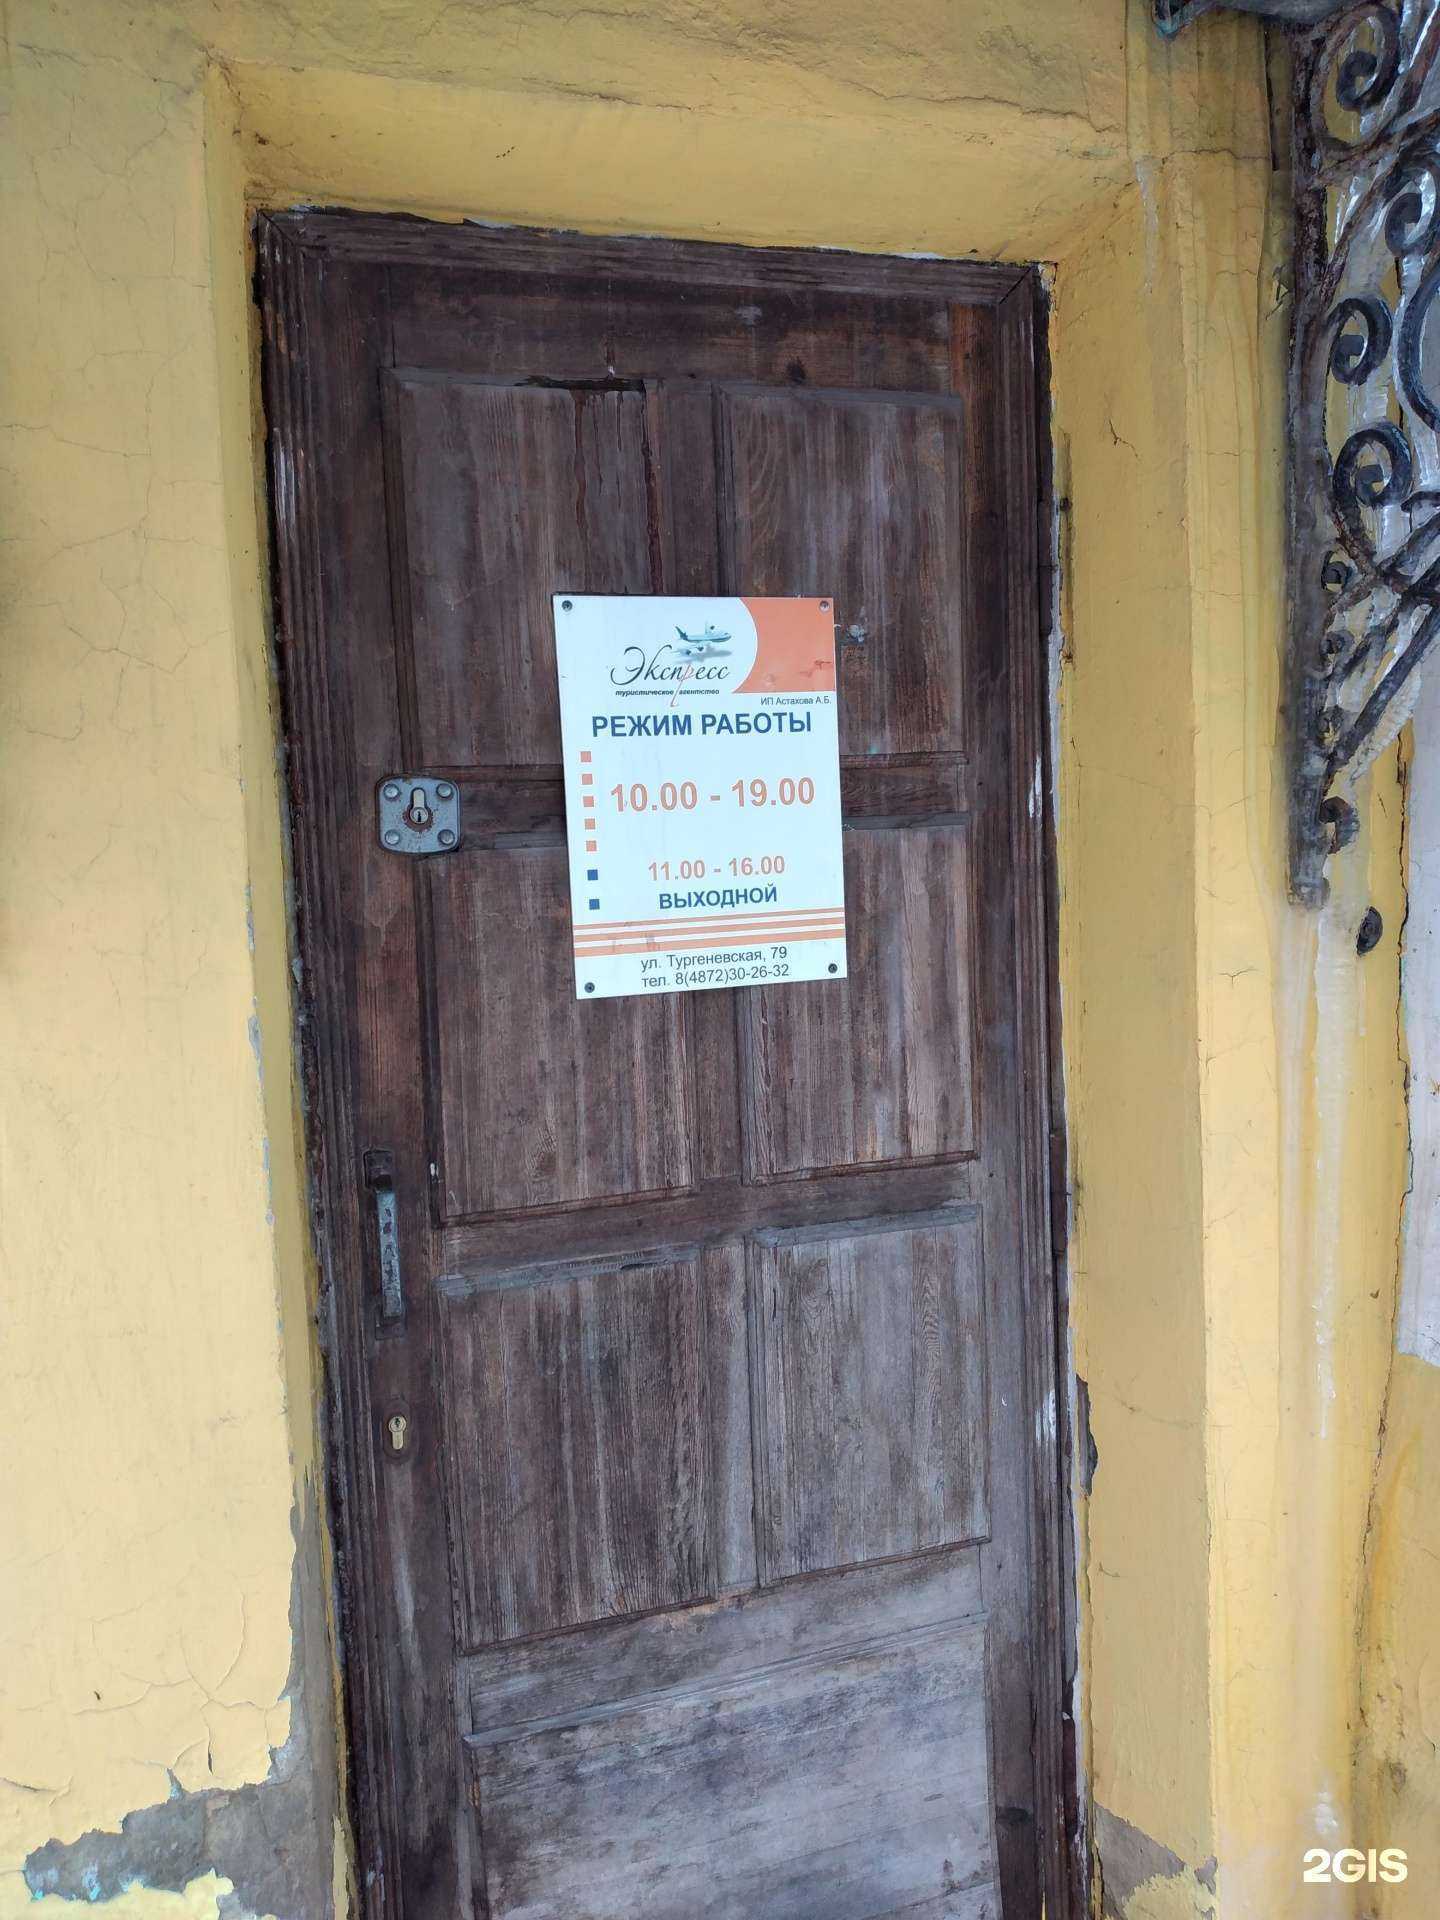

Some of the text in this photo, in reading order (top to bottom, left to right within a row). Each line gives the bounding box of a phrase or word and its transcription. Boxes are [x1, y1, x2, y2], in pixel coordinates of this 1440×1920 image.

[610, 644, 732, 708] Экспресс
[615, 688, 720, 697] туристическое агентство
[760, 694, 832, 706] ИП Астахова А.Б.
[592, 711, 812, 738] РЕЖИМ РАБОТЫ
[610, 781, 698, 812] 10.00
[731, 777, 815, 807] 19.00
[648, 859, 705, 881] 11.00
[729, 855, 786, 877] 16.00
[659, 883, 778, 910] ВЫХОДНОЙ
[640, 946, 788, 972] ул. Тургеневская, 79
[641, 963, 789, 988] тел. 8(4872)30-26-32
